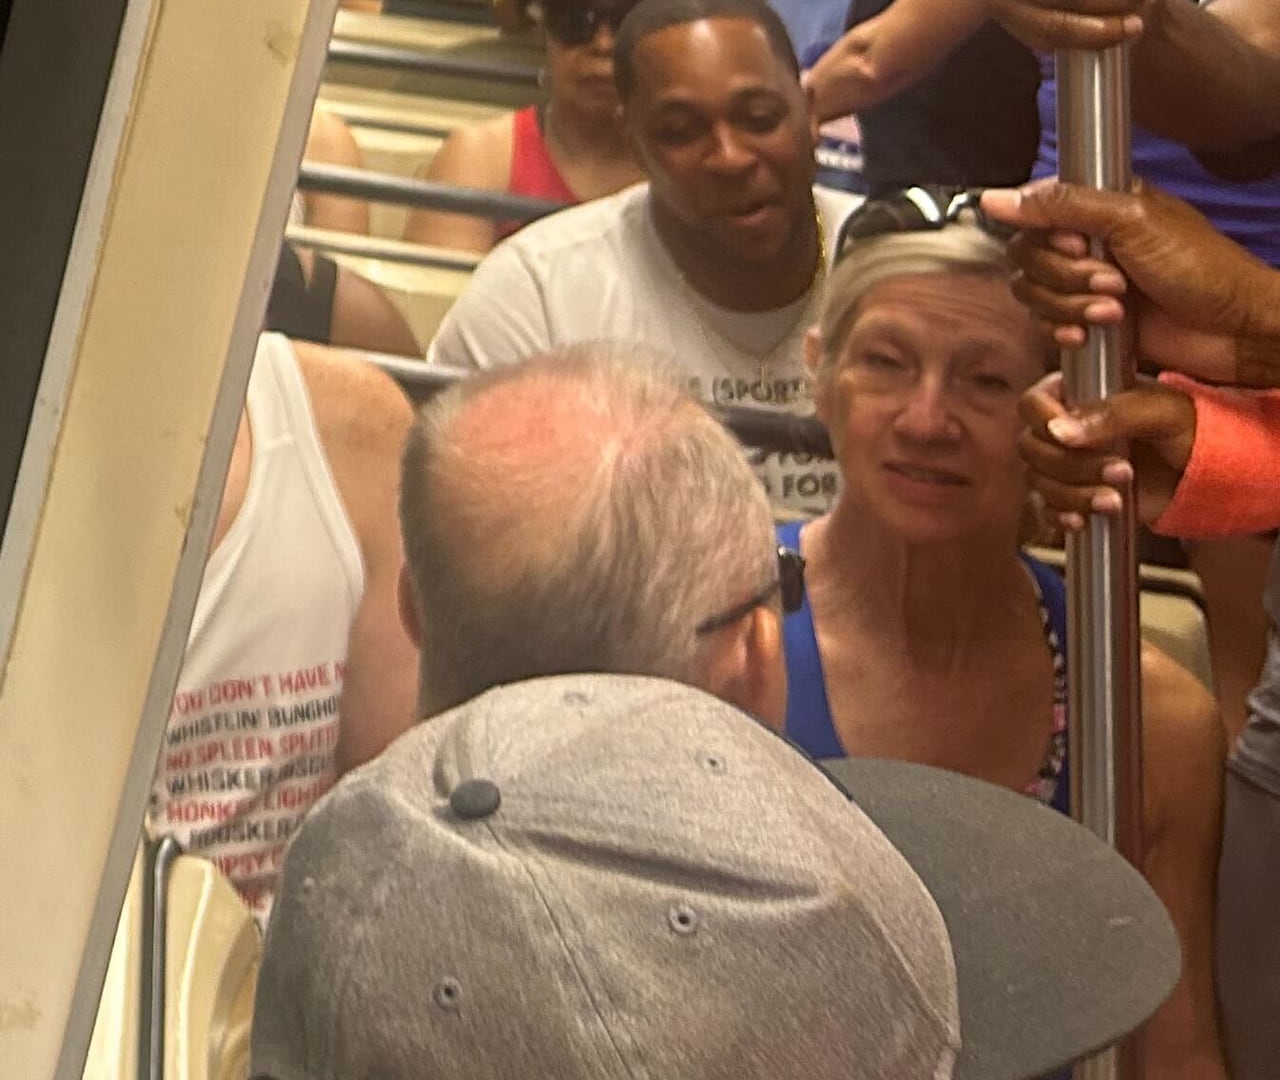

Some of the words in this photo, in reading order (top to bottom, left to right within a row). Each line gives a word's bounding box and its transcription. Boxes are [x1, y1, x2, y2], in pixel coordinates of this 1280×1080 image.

[208, 672, 271, 706] DON'T
[278, 662, 328, 697] HAVE
[267, 695, 338, 729] BUNGHO
